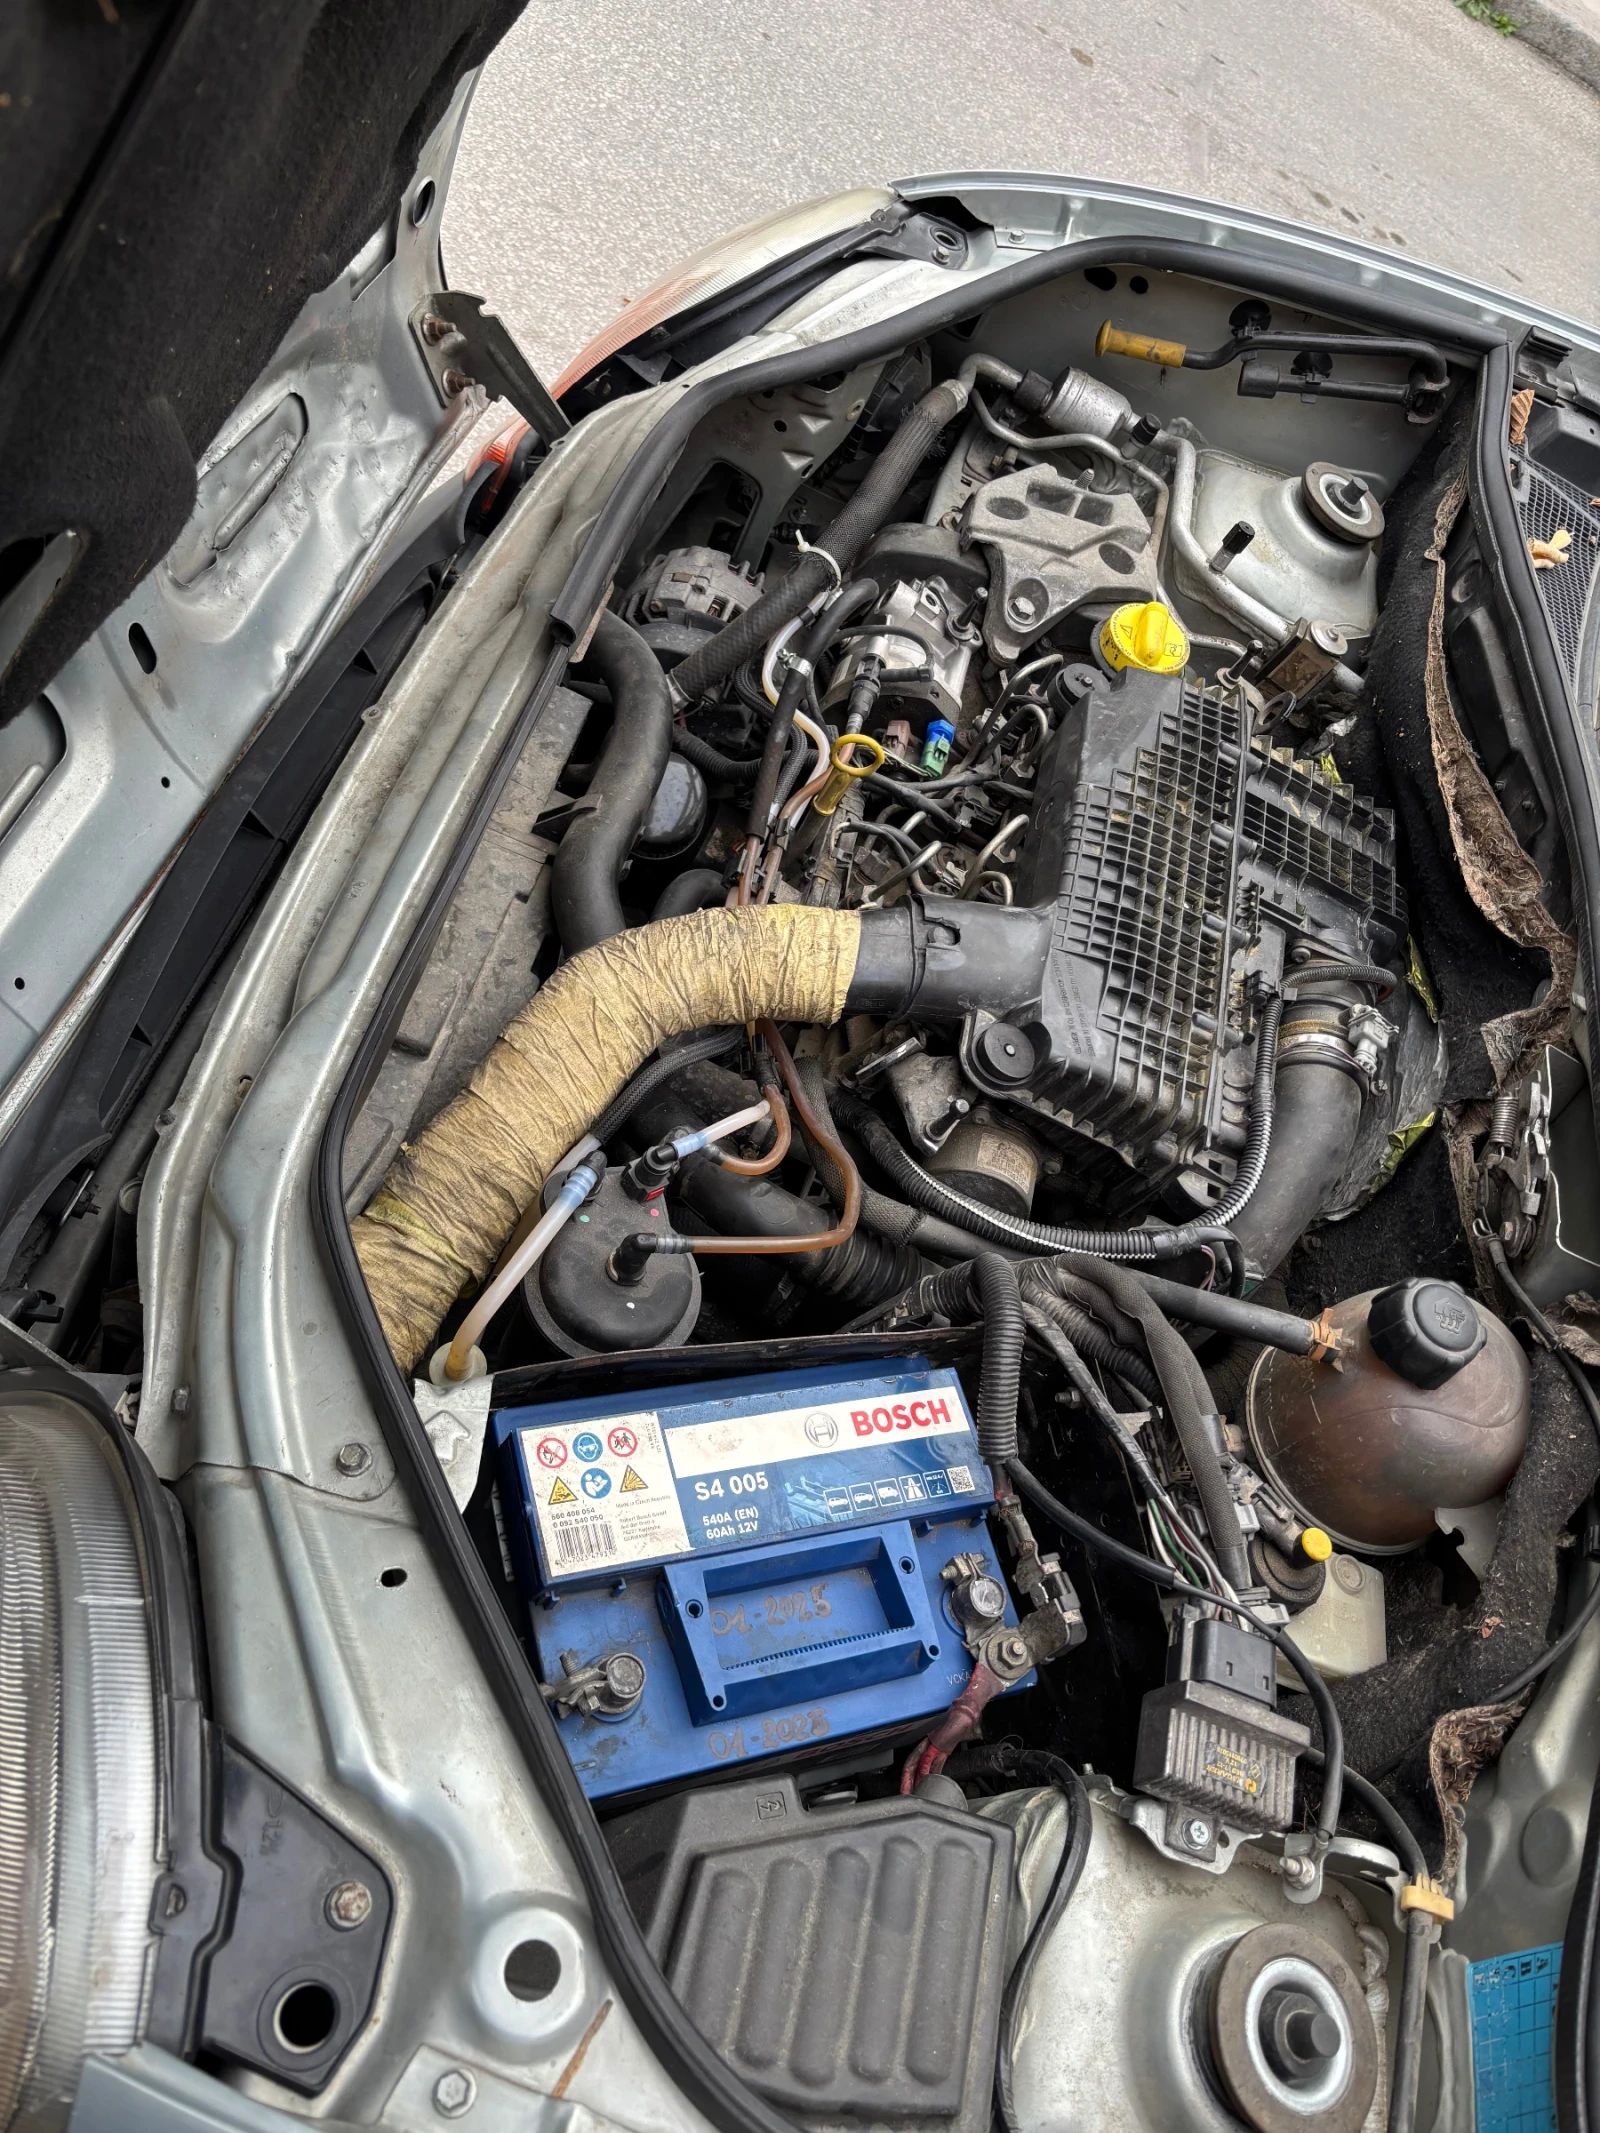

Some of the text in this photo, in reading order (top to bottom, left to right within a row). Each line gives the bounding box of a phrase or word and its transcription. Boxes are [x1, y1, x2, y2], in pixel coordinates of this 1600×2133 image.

[850, 1398, 952, 1437] BOSCH
[694, 1472, 769, 1501] S4 005
[582, 1507, 596, 1515] 054
[703, 1506, 759, 1526] 540A (EN)
[706, 1521, 759, 1540] 60Ah 12V
